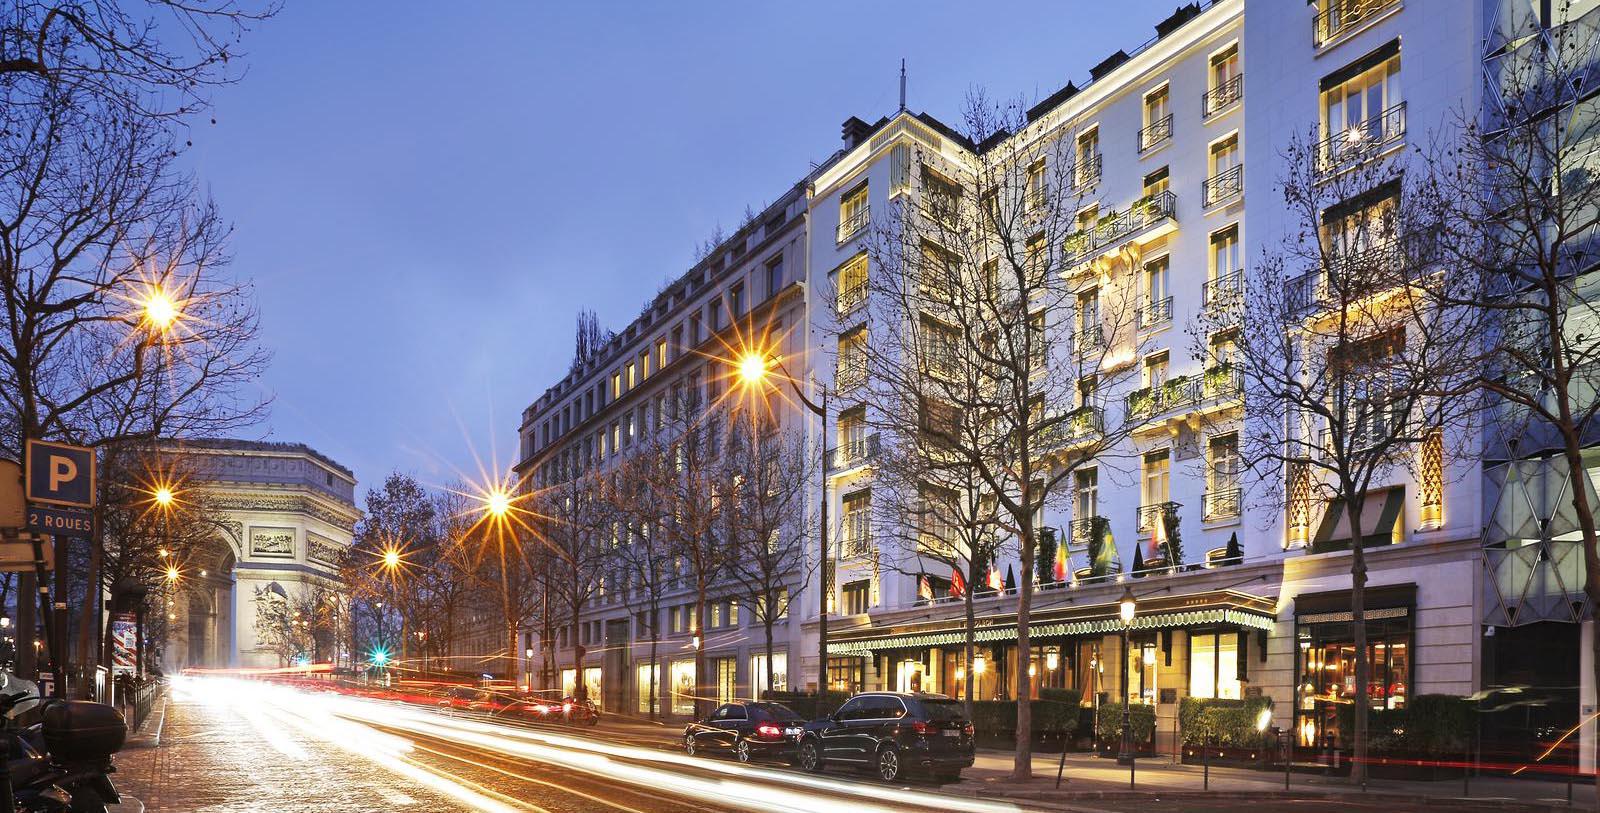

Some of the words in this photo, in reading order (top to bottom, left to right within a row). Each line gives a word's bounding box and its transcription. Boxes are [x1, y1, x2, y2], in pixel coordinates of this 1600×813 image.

[49, 455, 77, 491] P
[30, 513, 38, 525] 2
[45, 515, 91, 531] ROUES
